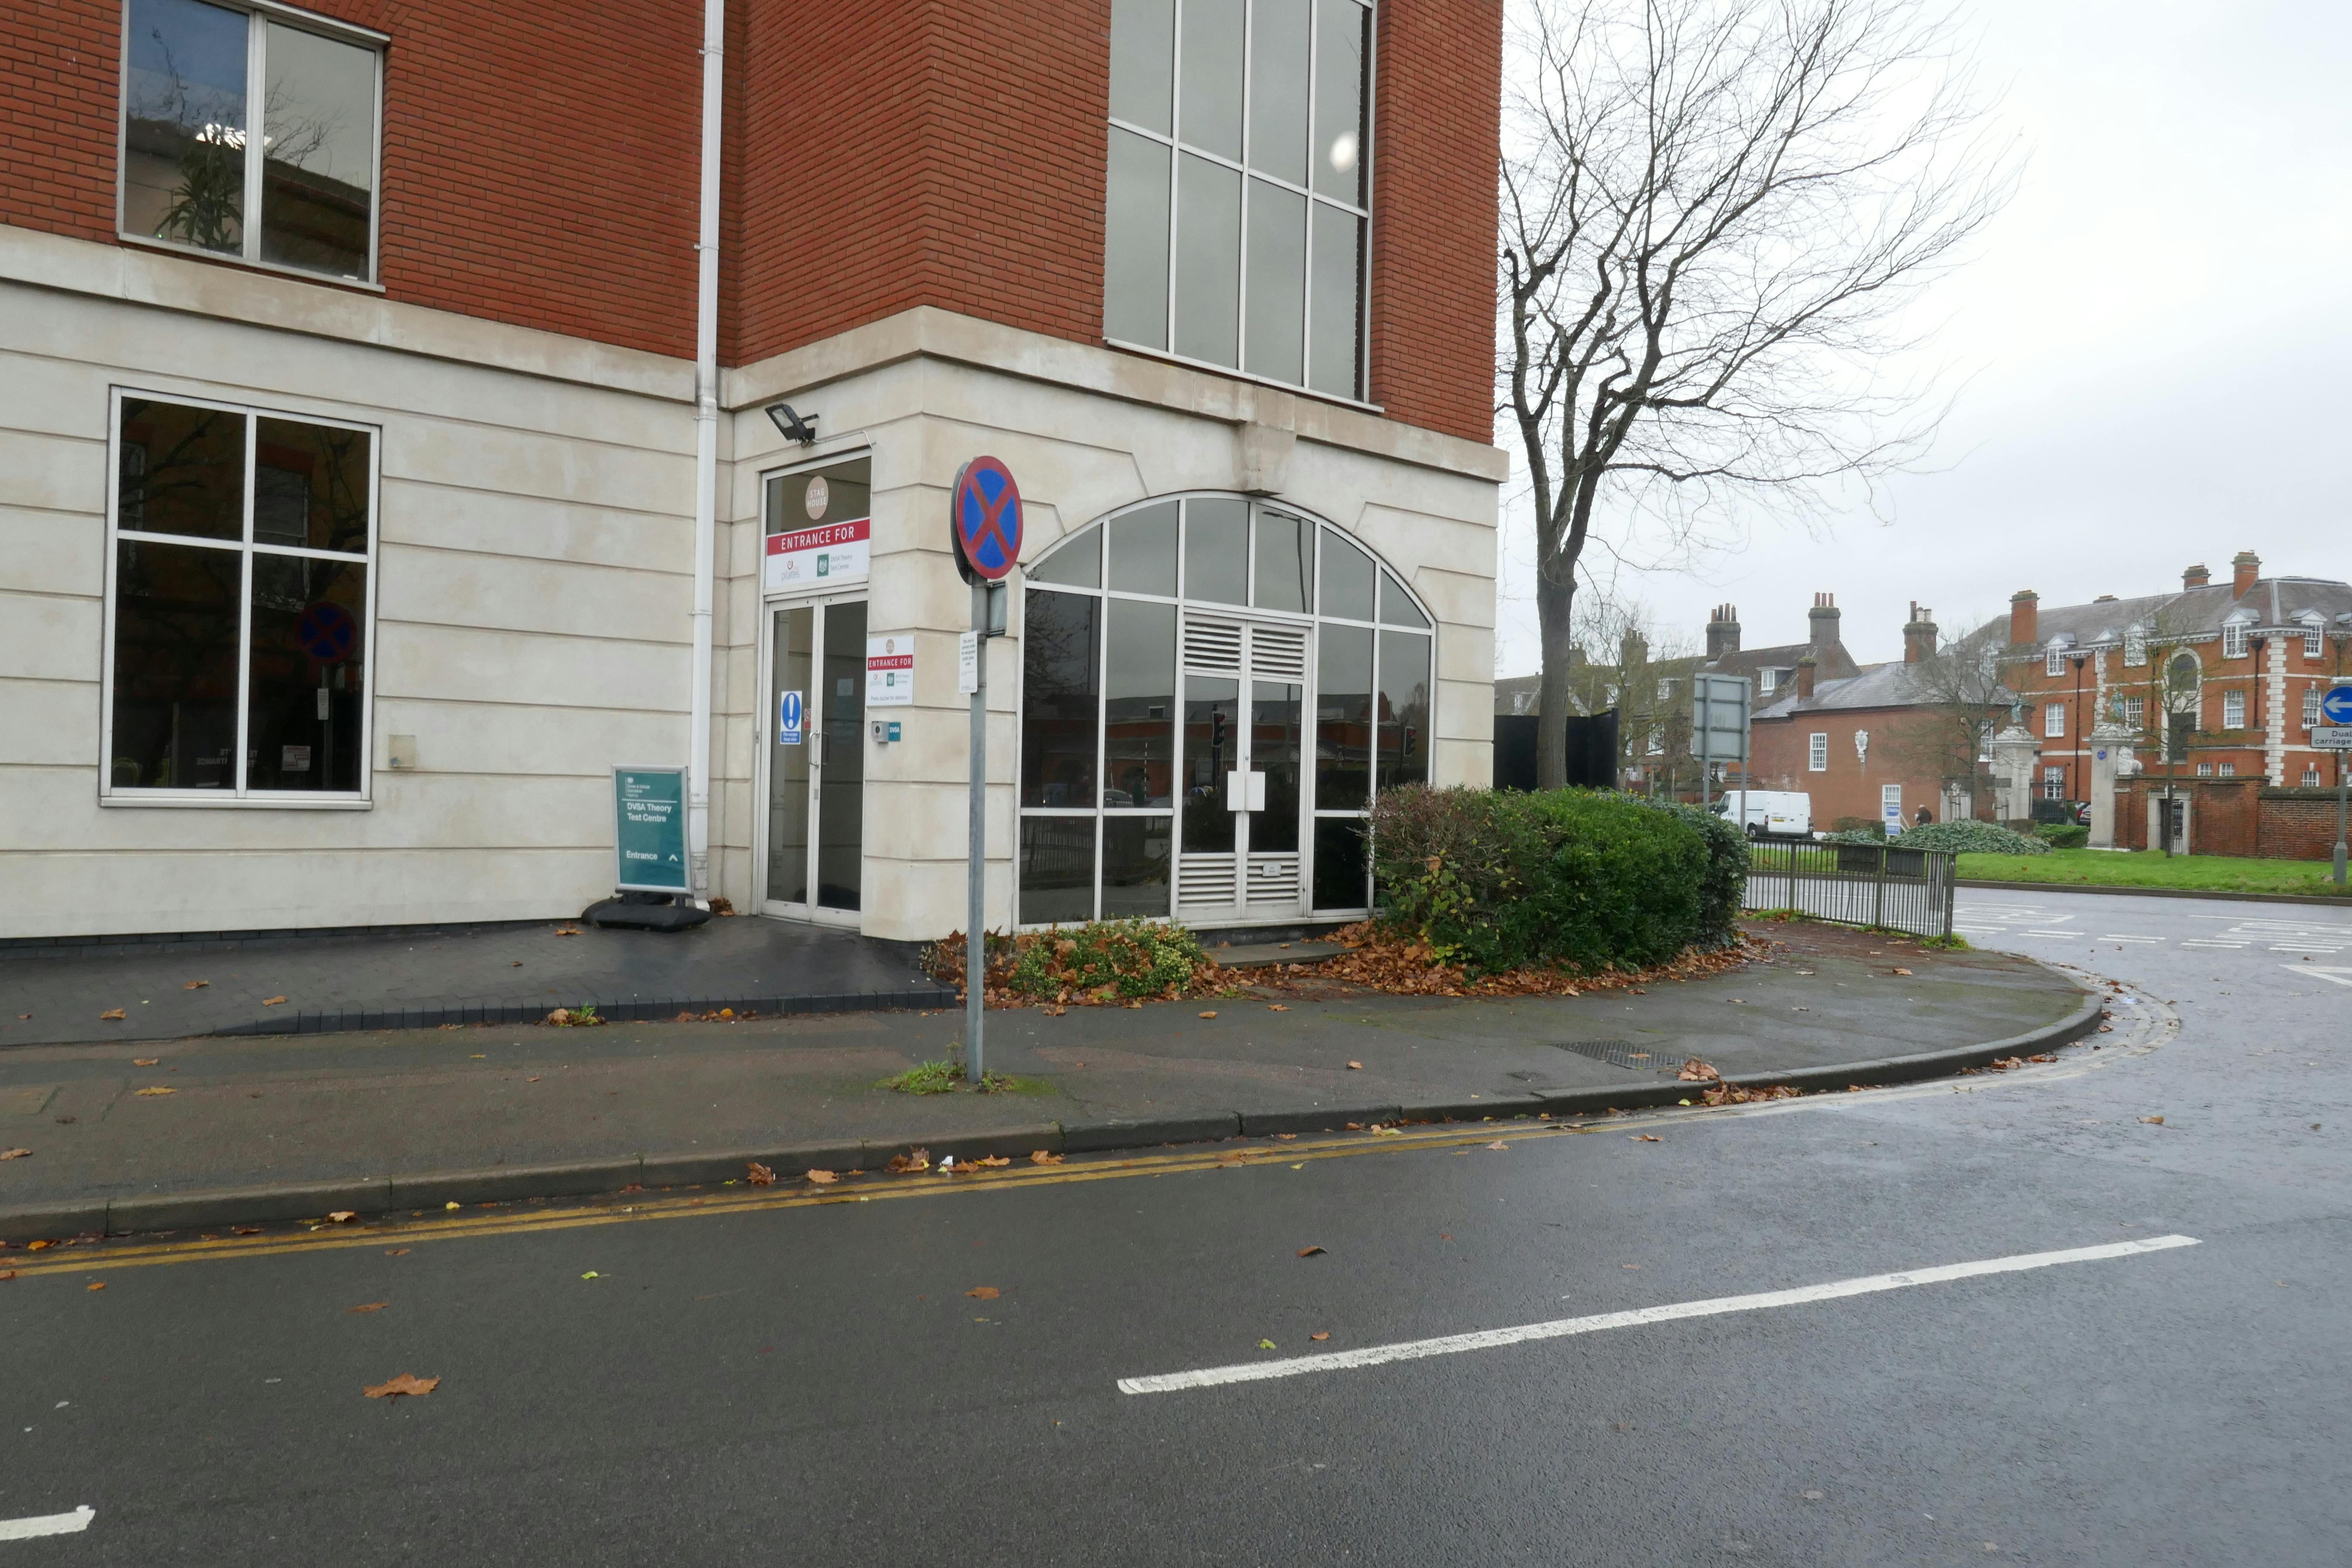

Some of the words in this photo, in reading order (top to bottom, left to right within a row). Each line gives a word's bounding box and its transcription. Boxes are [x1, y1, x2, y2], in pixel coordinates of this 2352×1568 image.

[810, 488, 825, 498] STAG
[807, 497, 827, 508] HOUSE
[781, 530, 831, 550] ENTRANCE
[835, 526, 854, 541] FOR
[781, 569, 800, 582] pilates
[869, 658, 898, 668] ENTRANCE
[900, 657, 912, 666] FOR
[627, 802, 646, 811] DVSA
[647, 804, 672, 814] Theory
[627, 813, 642, 821] Test
[643, 814, 667, 822] Centre
[626, 851, 658, 860] Entrance
